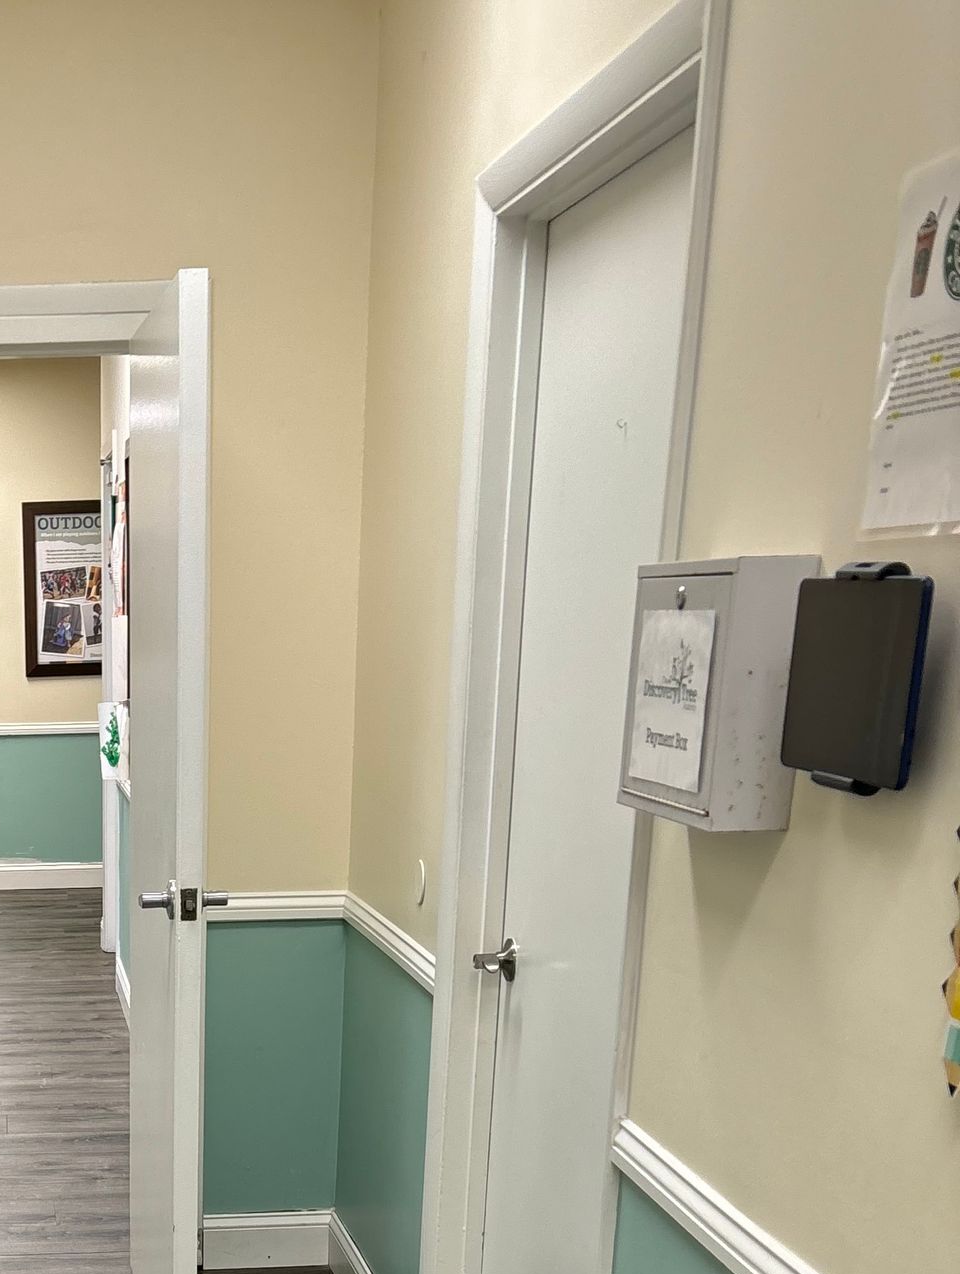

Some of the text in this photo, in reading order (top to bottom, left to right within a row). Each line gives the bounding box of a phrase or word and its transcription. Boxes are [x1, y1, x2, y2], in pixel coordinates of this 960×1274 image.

[681, 683, 697, 703] Tree
[645, 727, 688, 751] Payment Box
